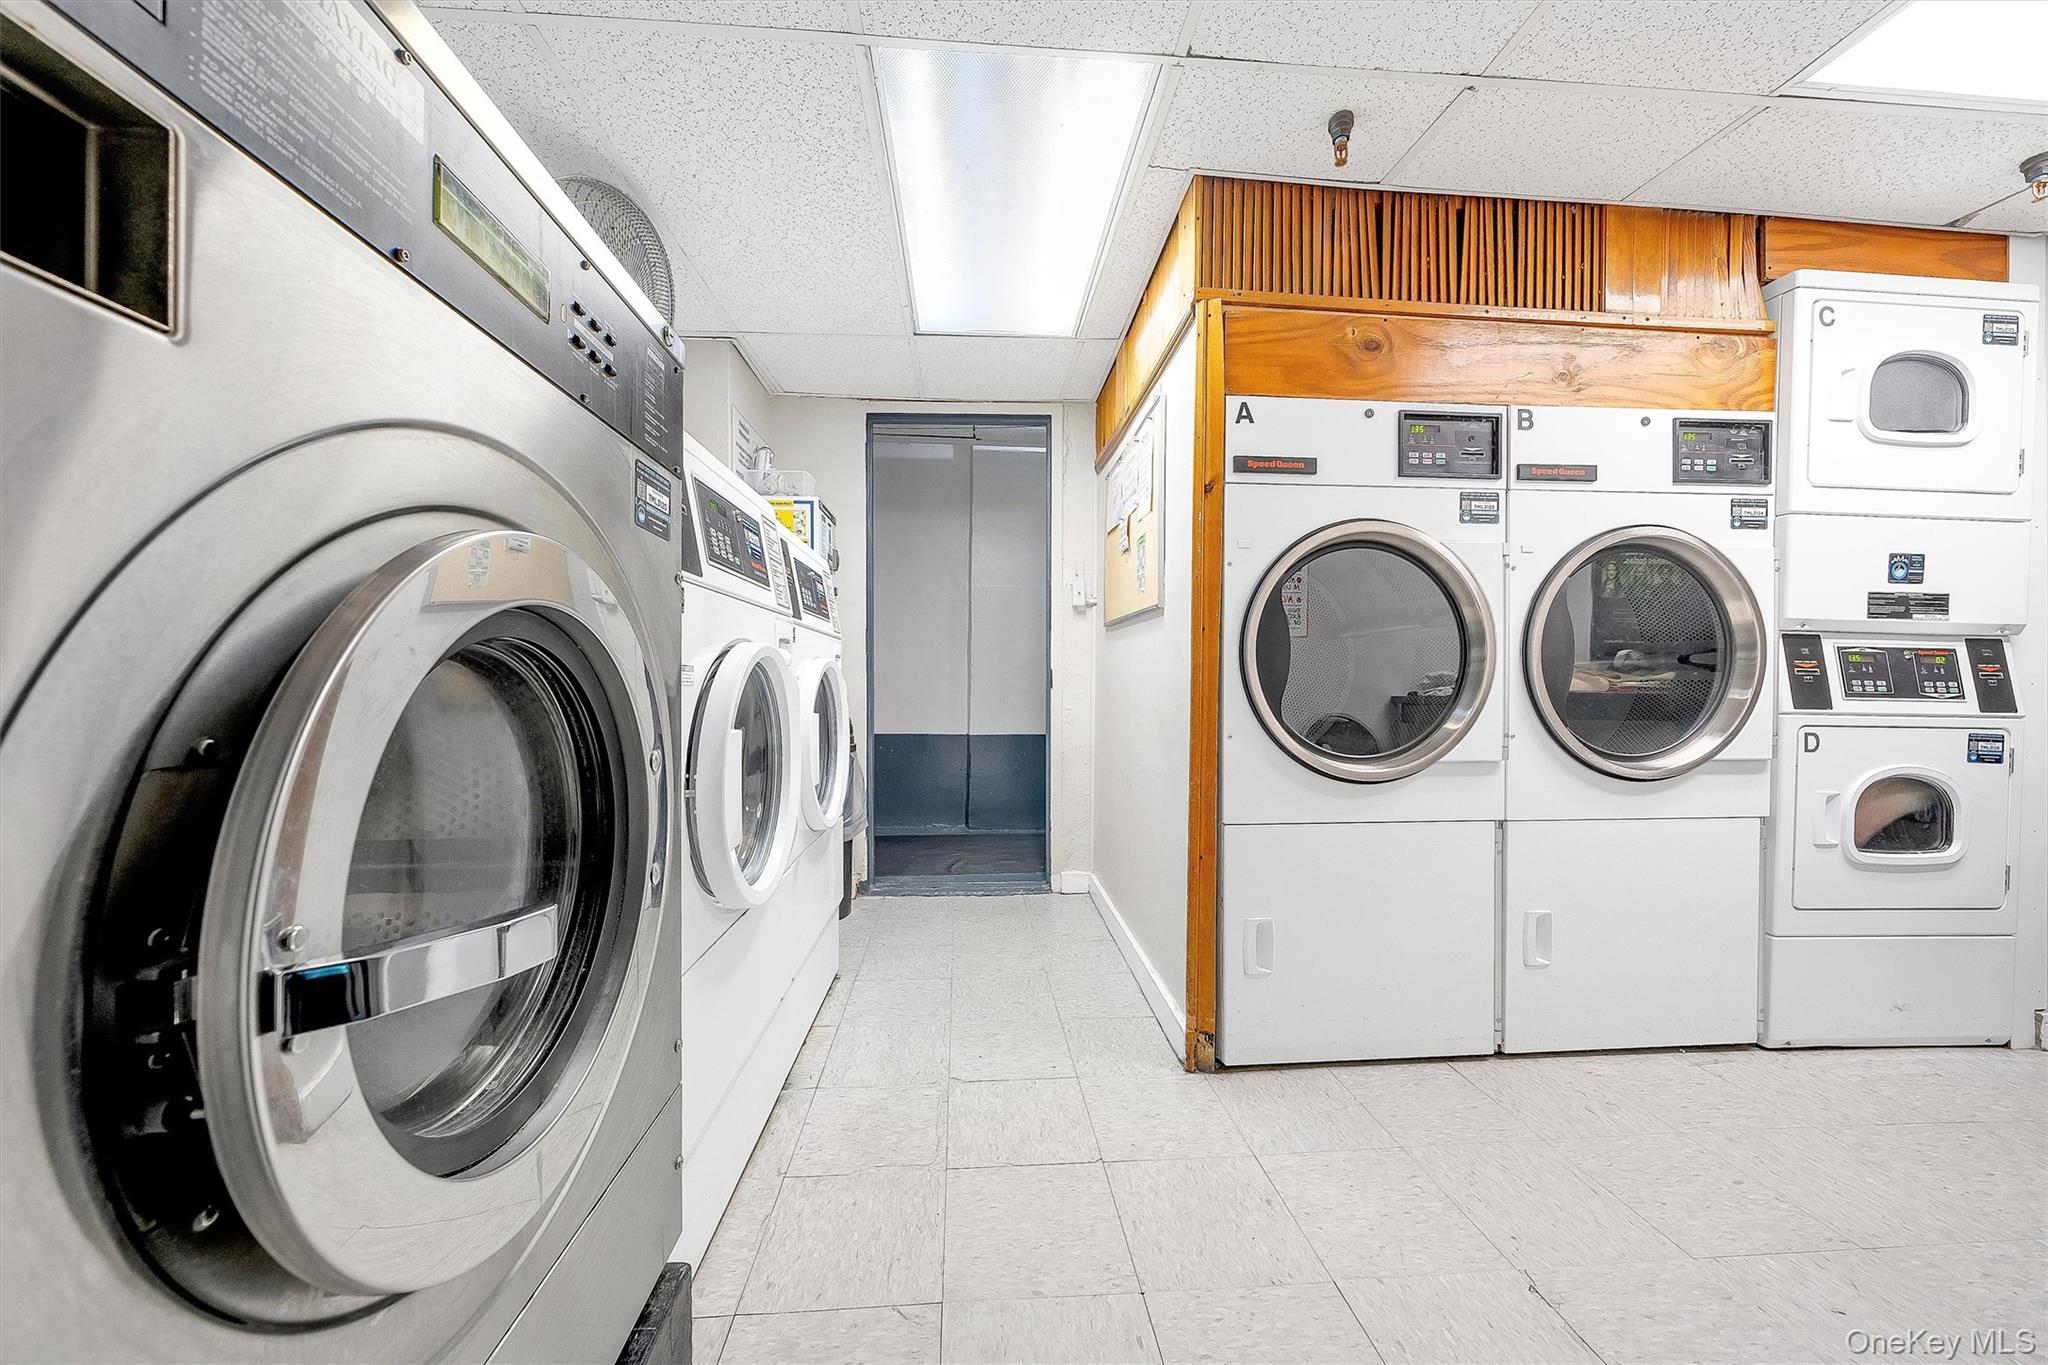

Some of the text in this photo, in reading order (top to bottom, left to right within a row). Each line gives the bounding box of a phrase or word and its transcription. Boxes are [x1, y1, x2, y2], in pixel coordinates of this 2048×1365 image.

[318, 0, 398, 88] AYTAG
[1819, 306, 1835, 327] C
[1235, 402, 1255, 424] A
[1517, 408, 1534, 431] B
[1247, 459, 1305, 469] Speed Queen
[1531, 467, 1586, 476] Speed Queen
[1804, 732, 1820, 753] D
